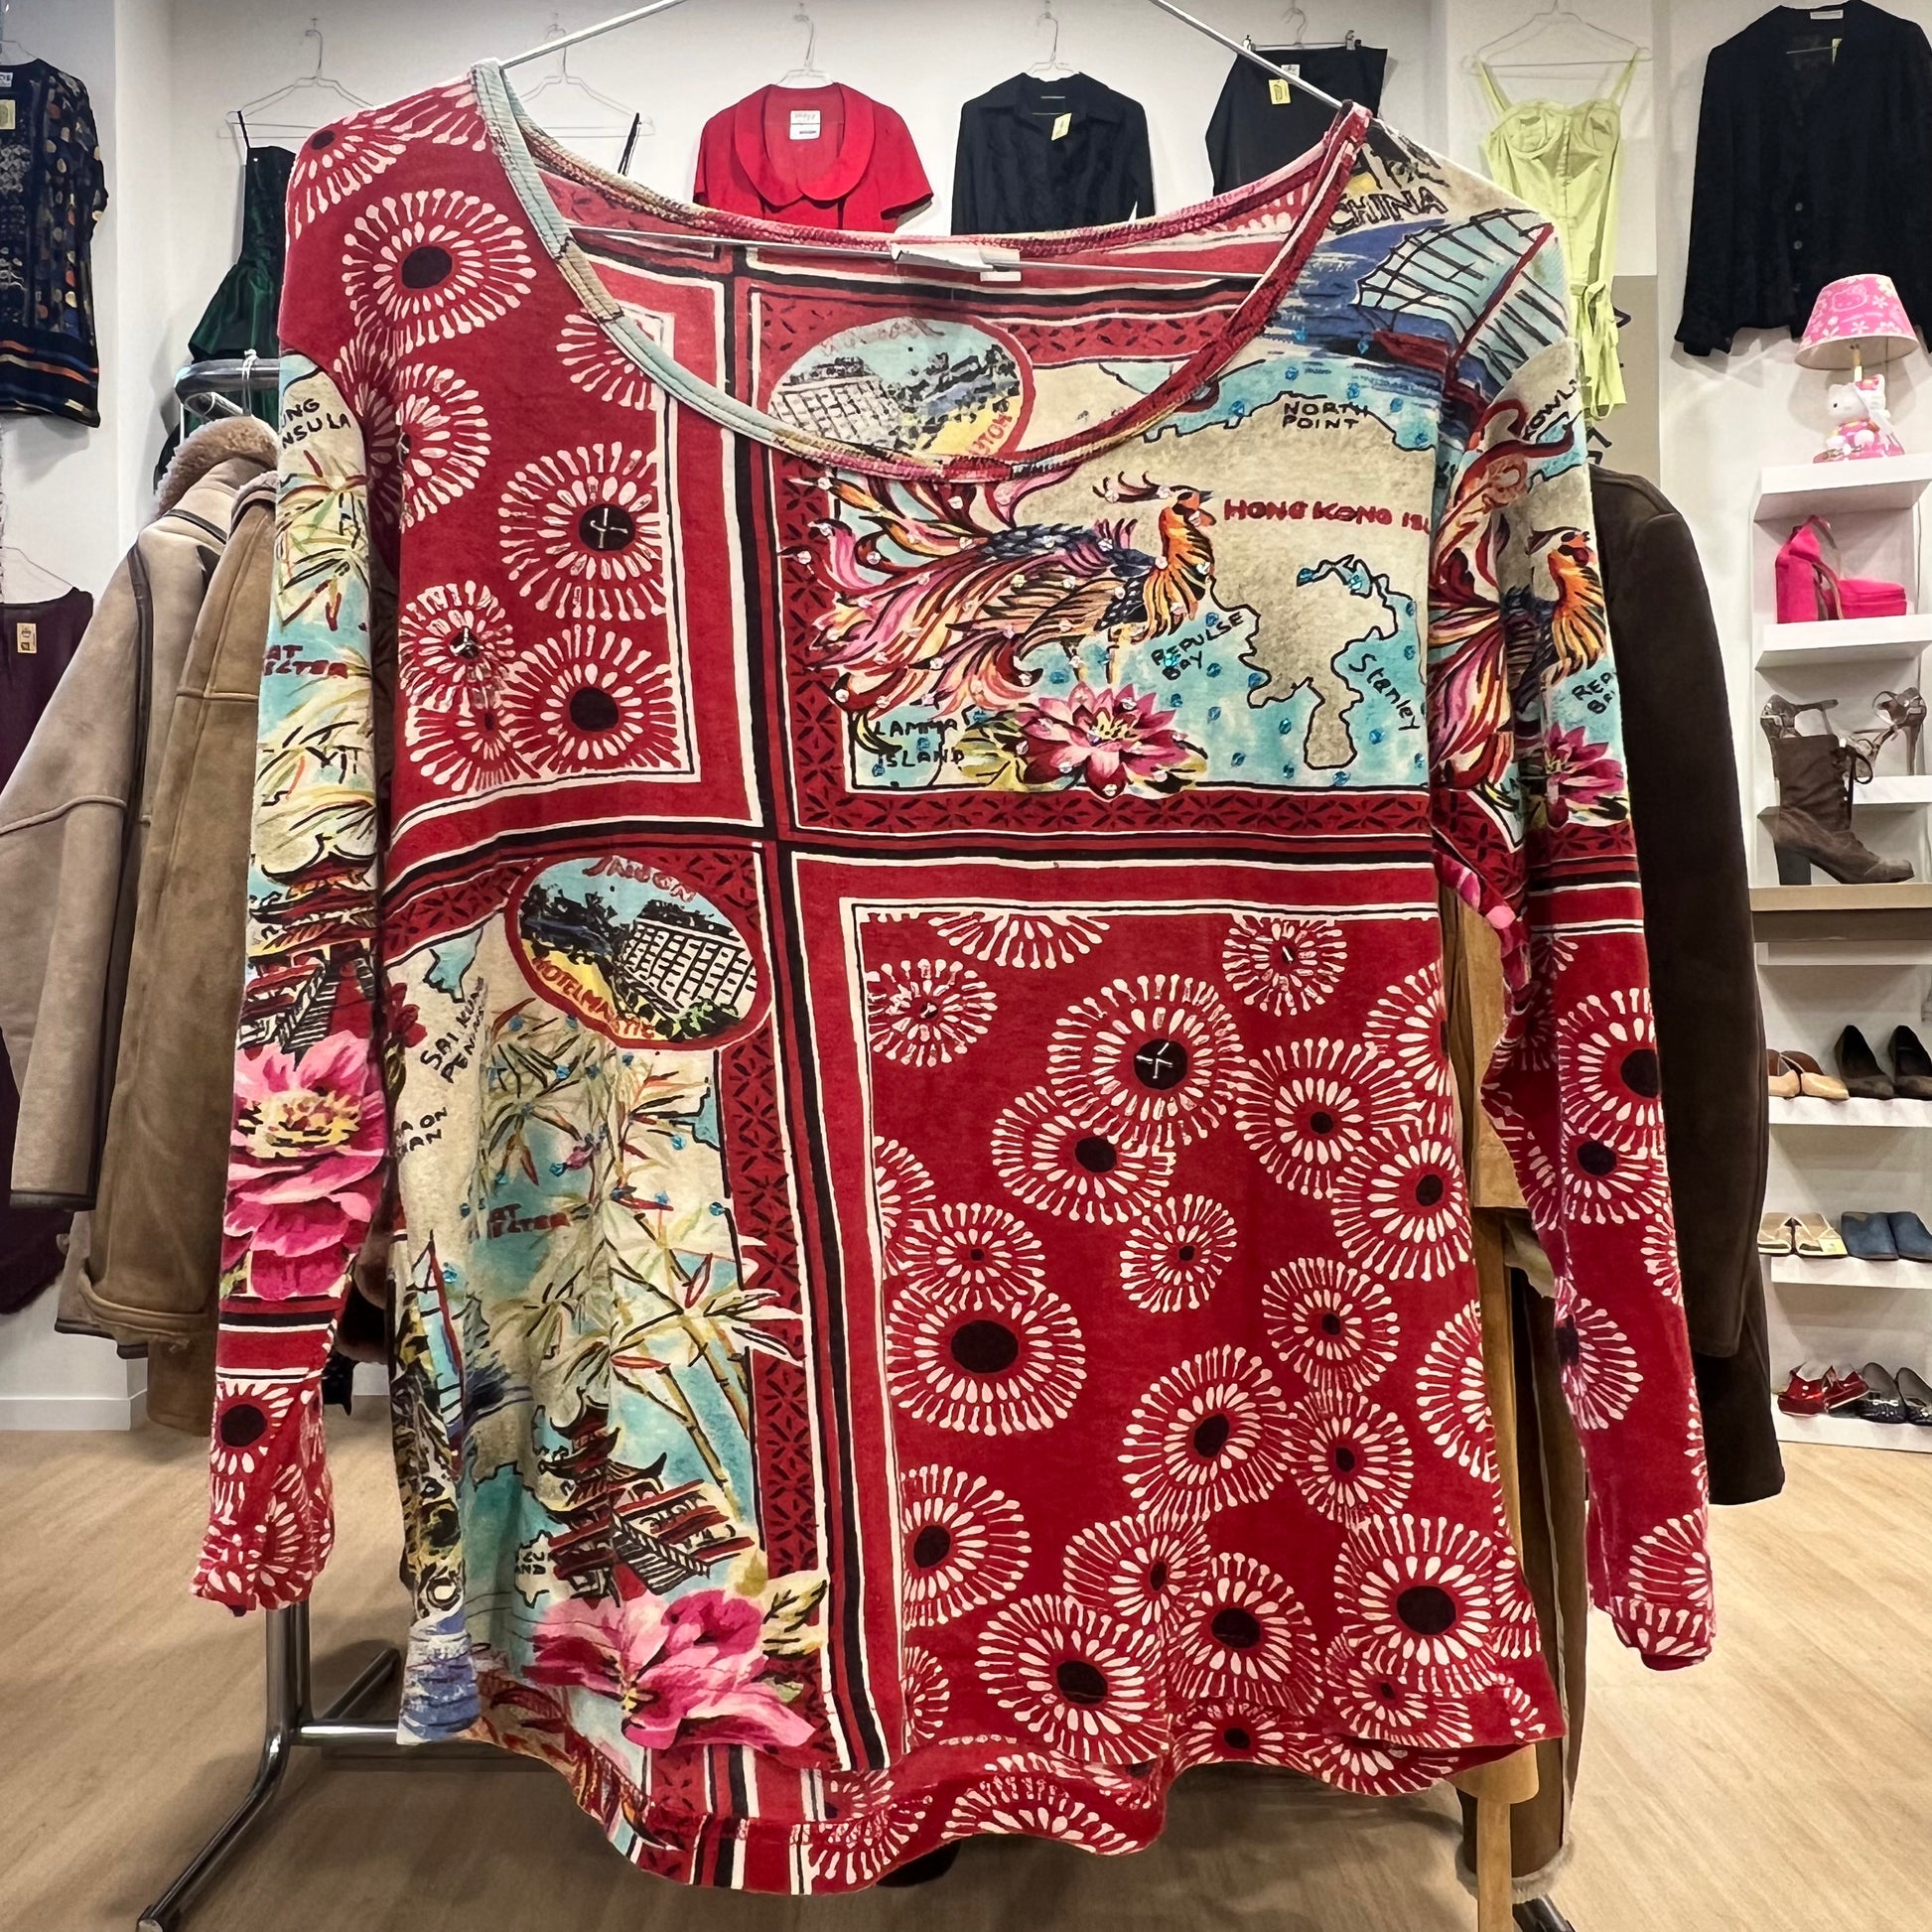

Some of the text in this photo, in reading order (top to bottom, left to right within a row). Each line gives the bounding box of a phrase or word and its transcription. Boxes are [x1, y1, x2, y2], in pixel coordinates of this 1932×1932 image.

[1327, 187, 1449, 235] CHINA
[1282, 415, 1359, 430] POINT
[1284, 401, 1368, 417] NORTH
[1224, 498, 1309, 521] HONG
[1312, 500, 1393, 525] KONG
[1151, 612, 1245, 666] REPULSE
[1348, 653, 1421, 732] Stanley
[420, 1032, 459, 1071] SAI
[420, 1107, 448, 1129] ON
